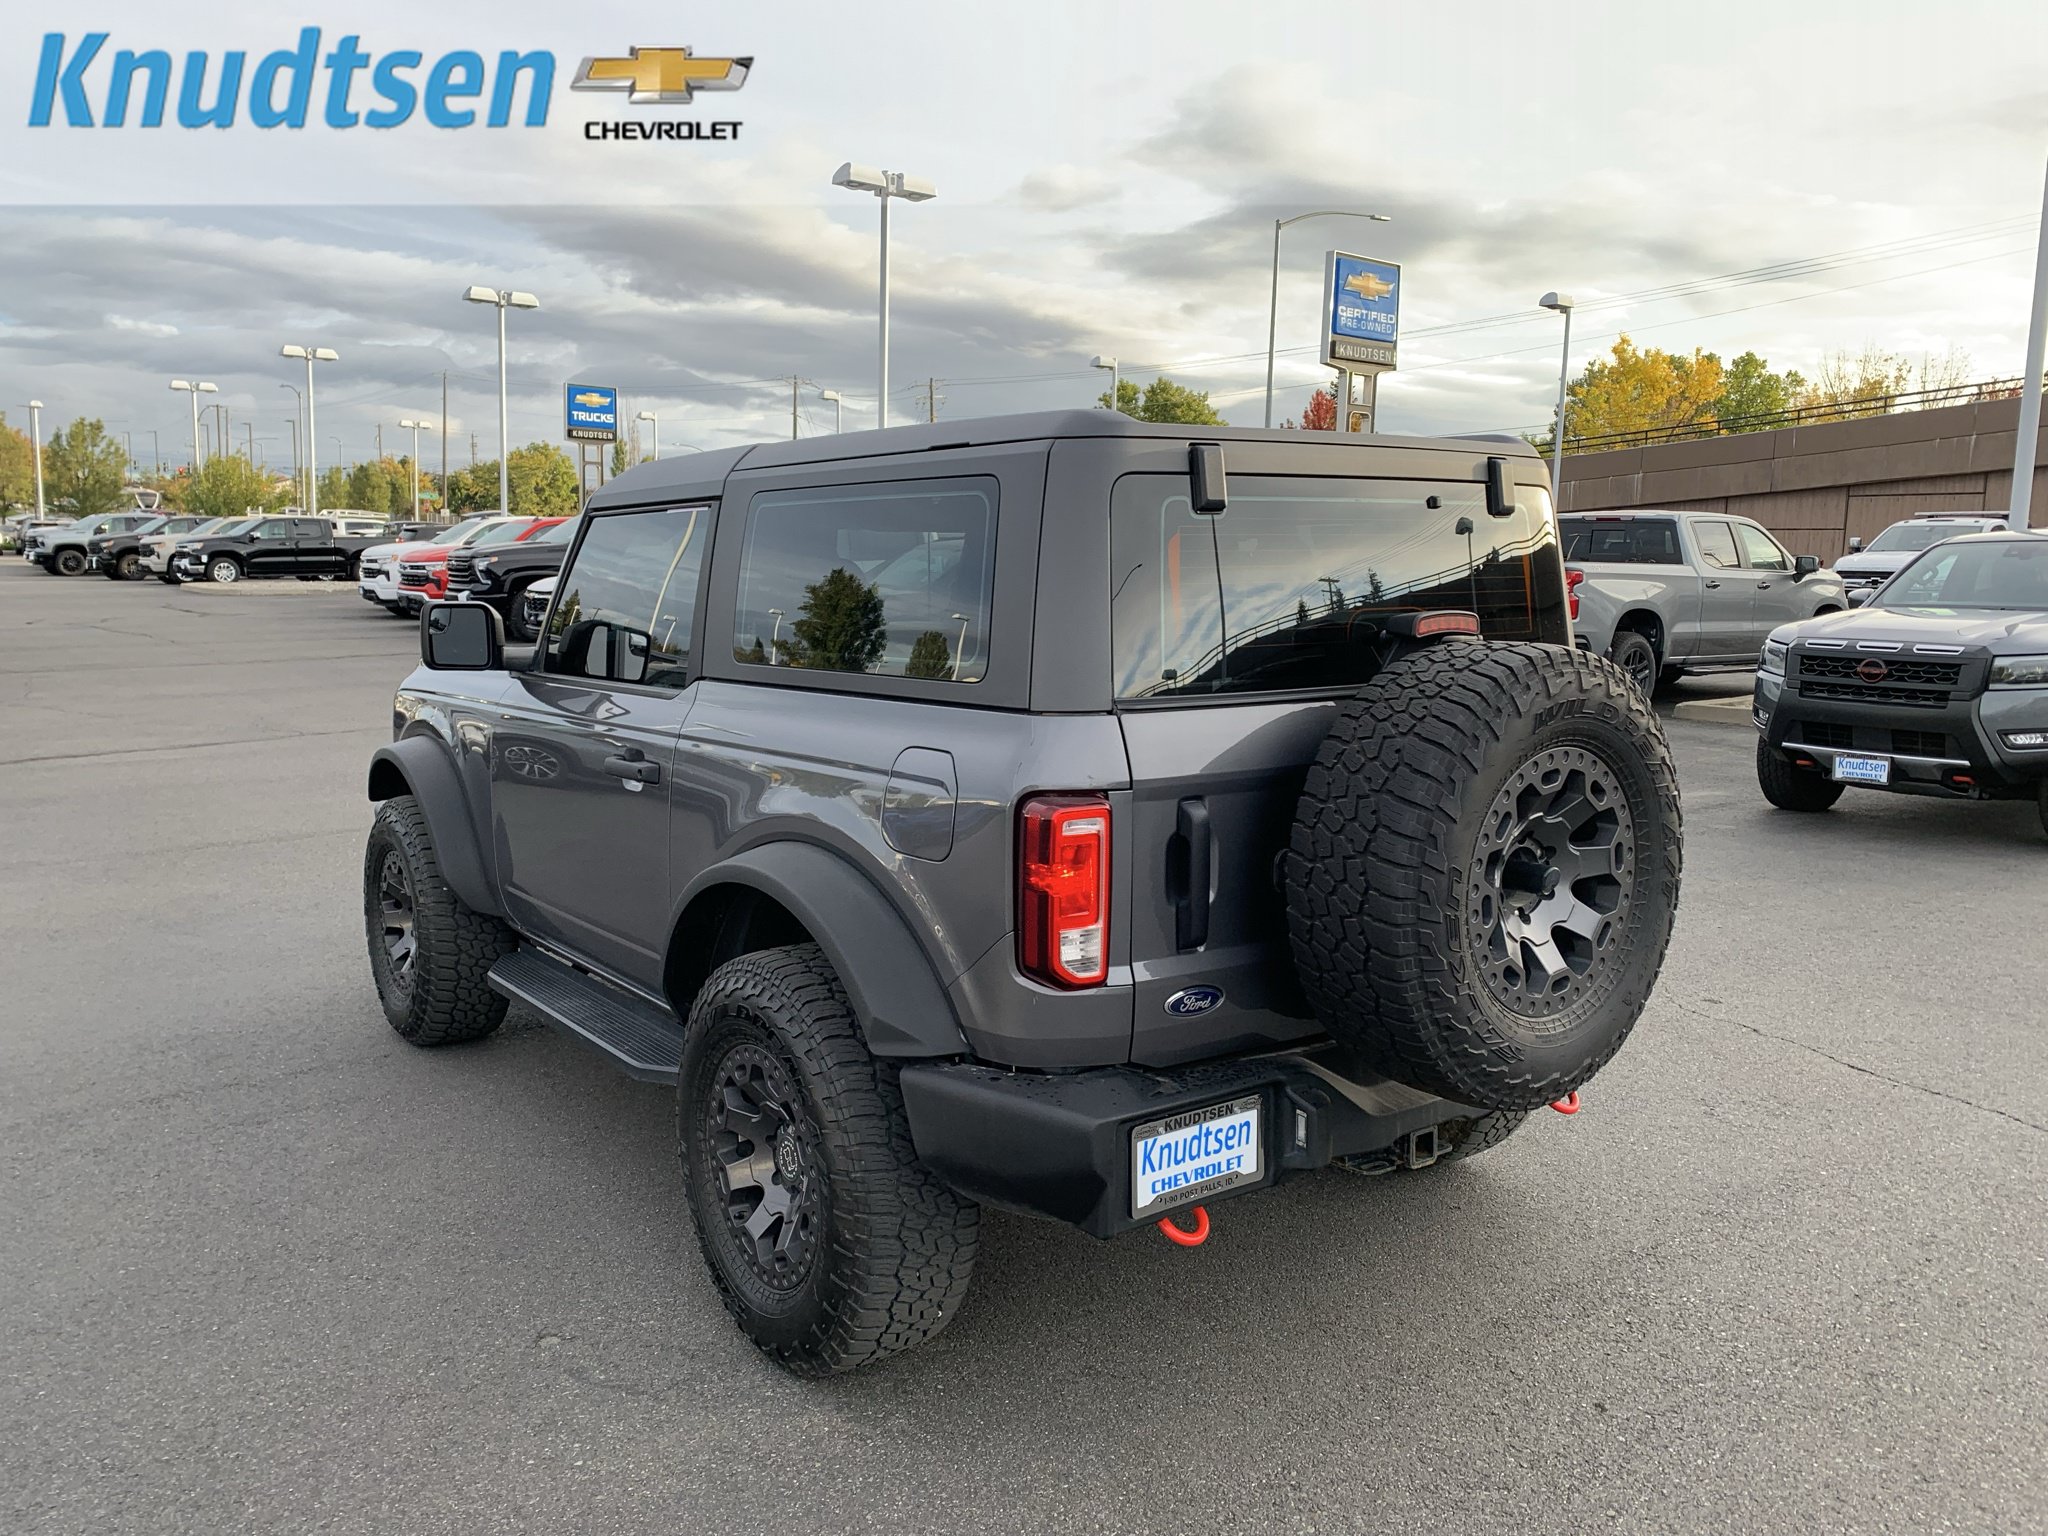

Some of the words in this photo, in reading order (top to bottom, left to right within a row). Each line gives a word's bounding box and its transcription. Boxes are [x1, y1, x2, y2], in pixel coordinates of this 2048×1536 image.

[1338, 305, 1395, 324] CERTIFIED
[1340, 317, 1392, 334] PRE-OWNED
[1340, 344, 1392, 361] KNUDTSEN
[571, 410, 614, 424] TRUCKS
[572, 430, 613, 440] KNUDTSEN
[1838, 757, 1886, 773] Knudtsen
[1841, 770, 1883, 780] CHEVROLET
[1180, 994, 1211, 1012] Ford
[1164, 1103, 1234, 1132] KNUDTSEN
[1141, 1120, 1251, 1176] Knudtsen
[1151, 1154, 1244, 1194] CHEVROLET
[1164, 1195, 1178, 1205] I-90
[1180, 1188, 1198, 1200] POST
[1200, 1180, 1224, 1194] FALLS,
